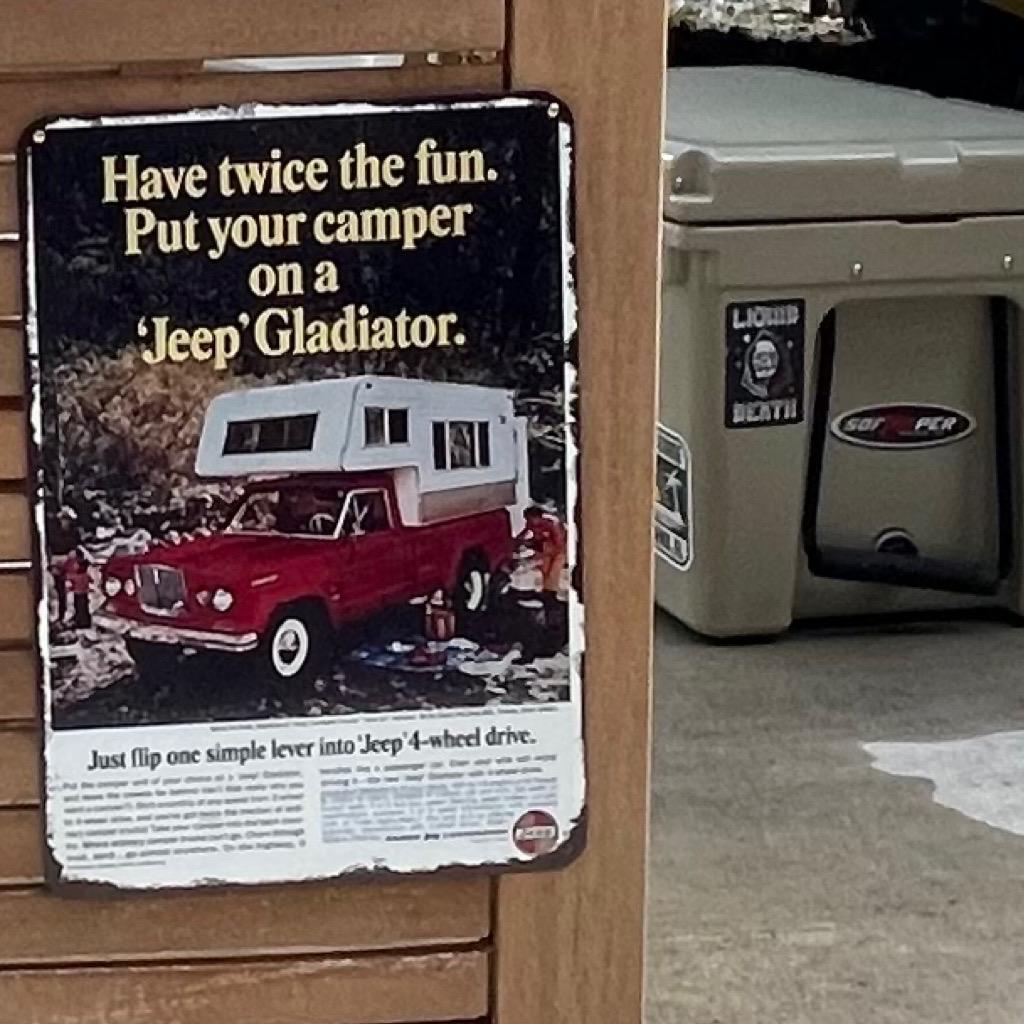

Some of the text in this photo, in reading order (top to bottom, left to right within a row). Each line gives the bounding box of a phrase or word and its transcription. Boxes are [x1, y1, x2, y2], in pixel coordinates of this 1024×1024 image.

[102, 138, 498, 203] Have twice the fun.
[124, 202, 474, 259] Put your camper
[248, 259, 340, 297] on a
[253, 304, 467, 357] Gladiator.
[87, 749, 126, 770] Just
[131, 747, 162, 771] flip
[166, 749, 201, 765] one
[206, 738, 266, 765] simple
[271, 738, 315, 759] lever
[319, 736, 355, 755] into
[408, 726, 481, 752] 4-wheel
[485, 725, 537, 746] drive.
